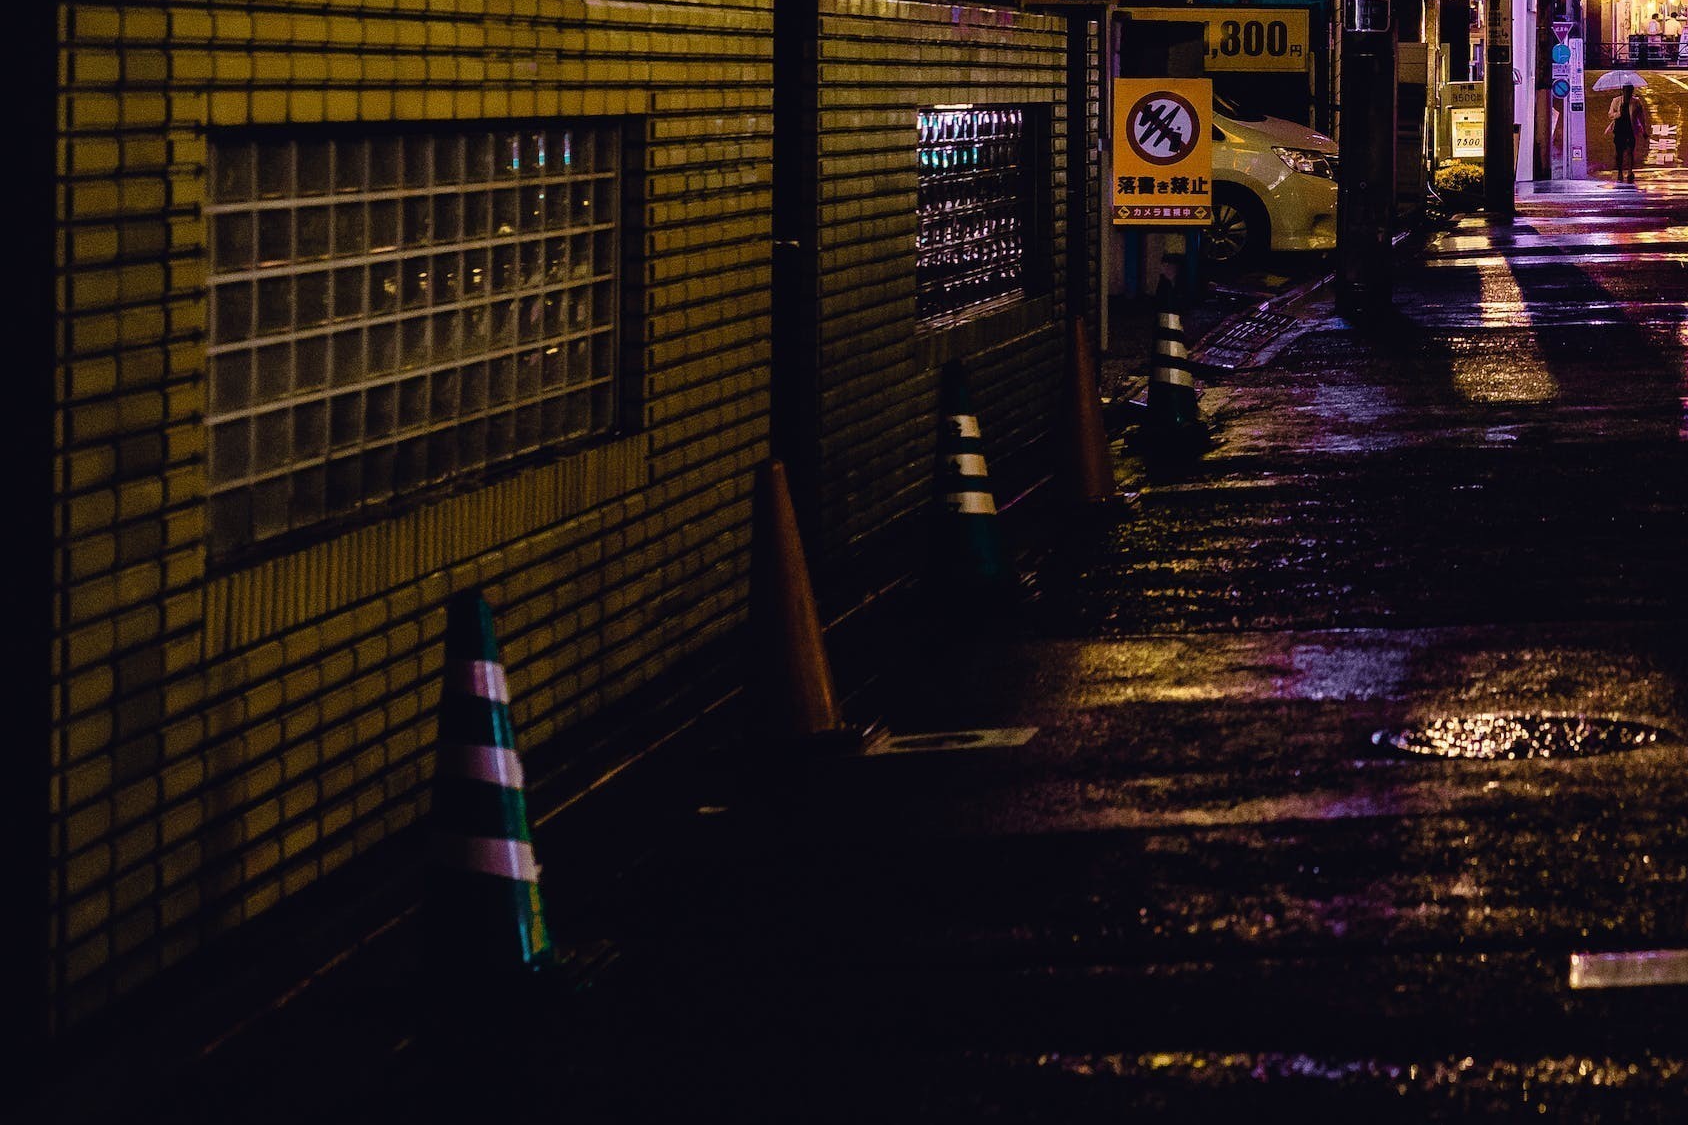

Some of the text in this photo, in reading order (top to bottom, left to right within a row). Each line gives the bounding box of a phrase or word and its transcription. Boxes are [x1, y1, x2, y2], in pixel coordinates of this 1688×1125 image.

[1117, 176, 1209, 195] 落書き禁止
